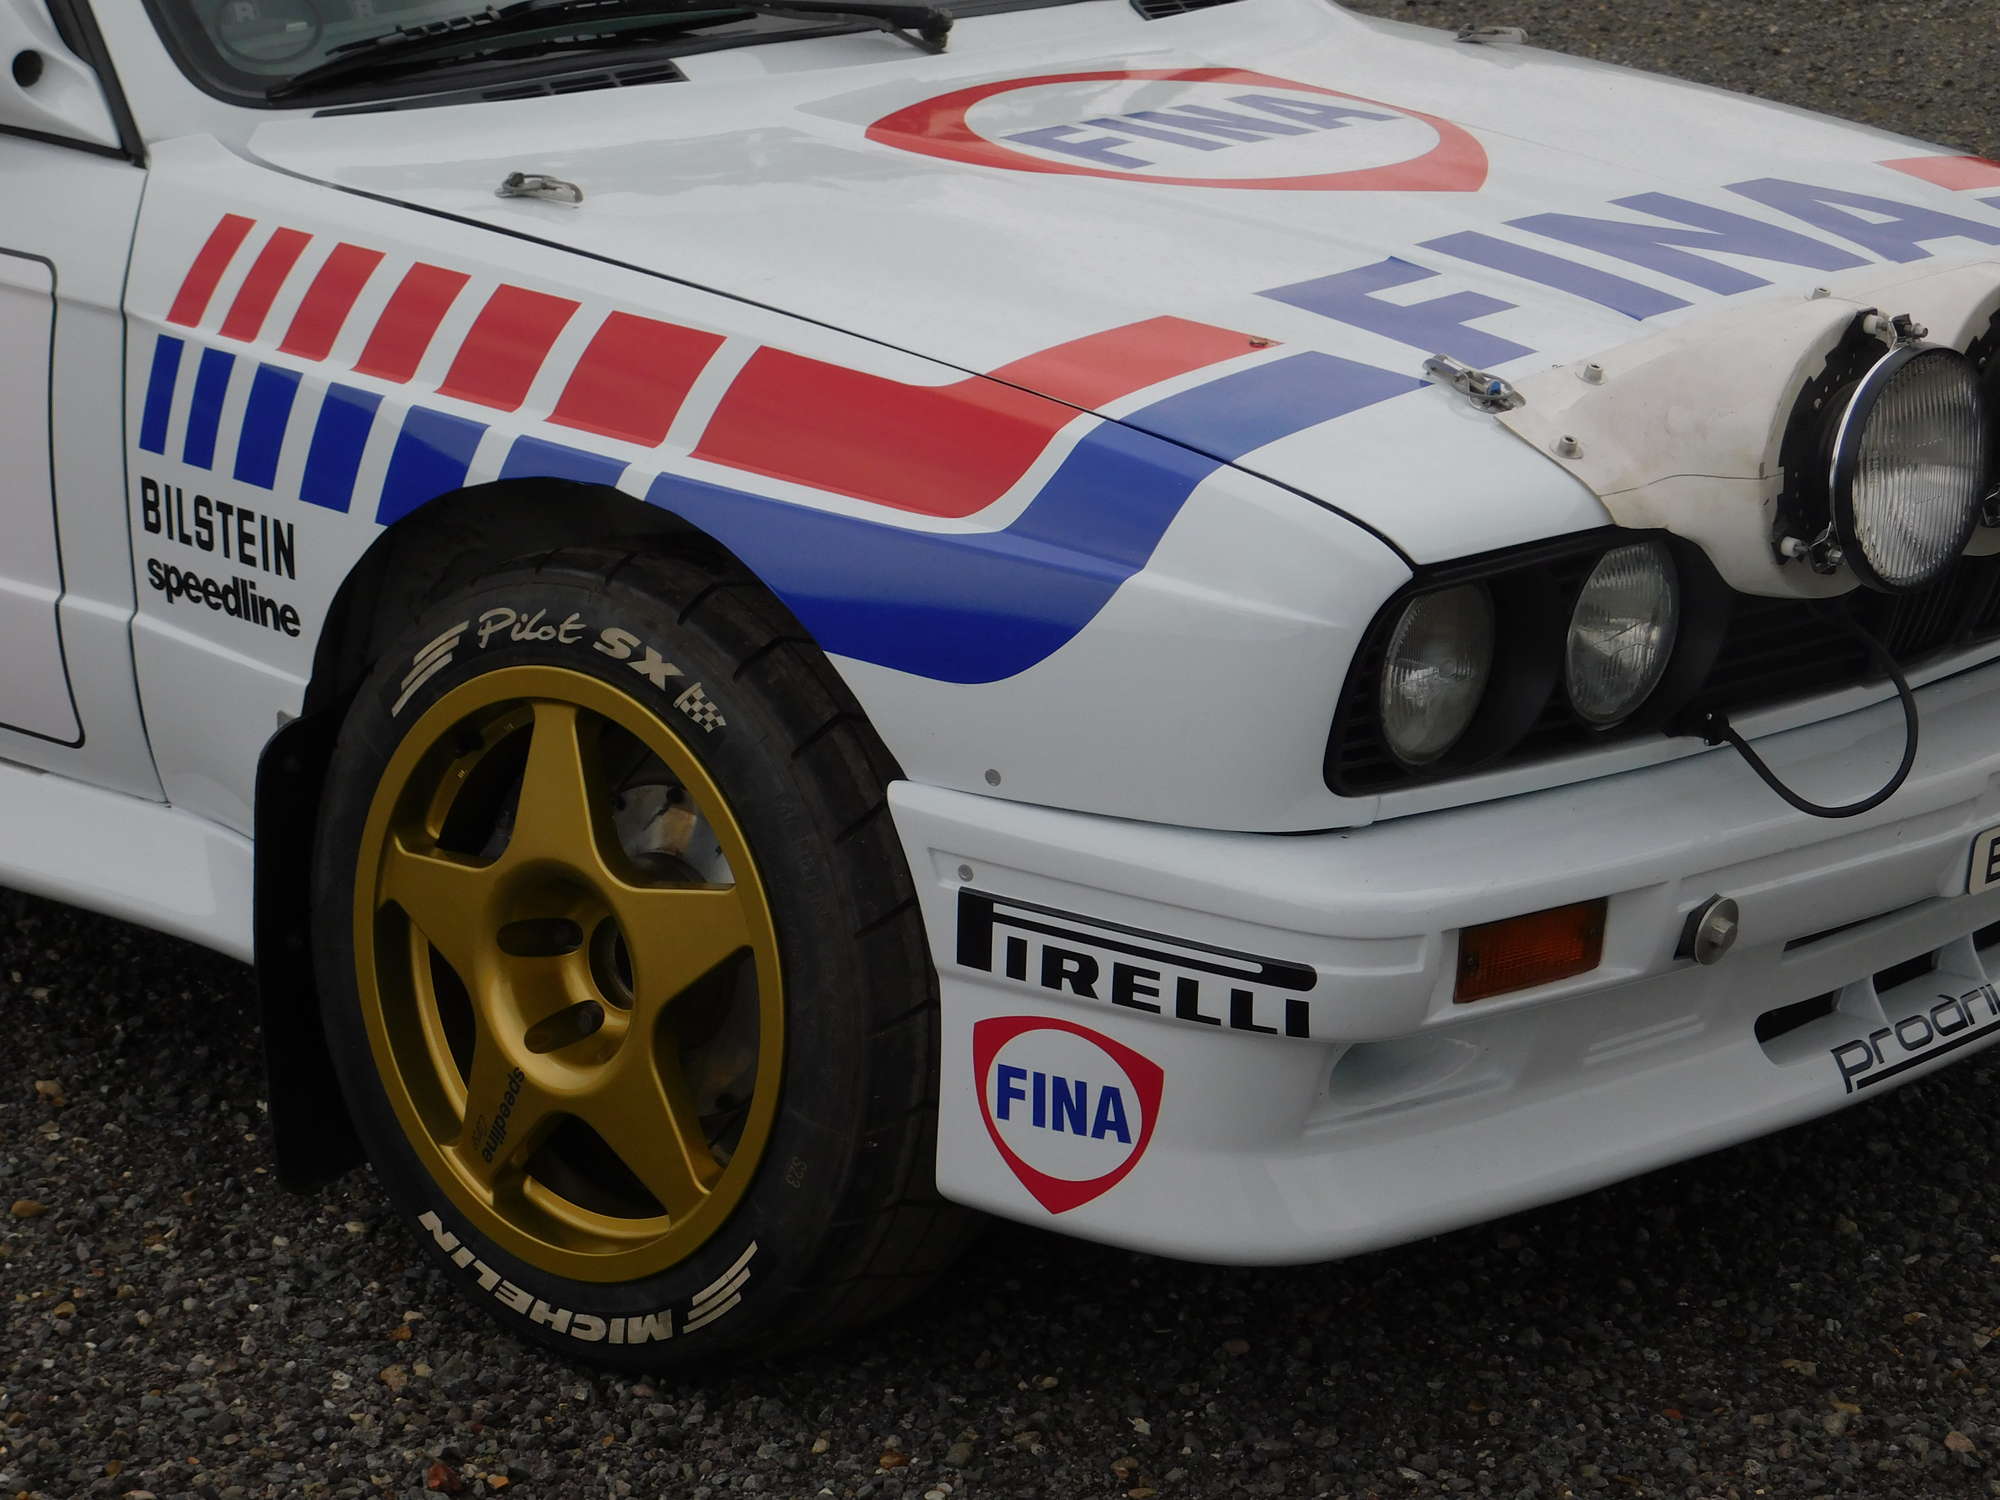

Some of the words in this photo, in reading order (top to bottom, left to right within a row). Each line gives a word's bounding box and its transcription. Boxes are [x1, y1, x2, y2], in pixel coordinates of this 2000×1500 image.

[999, 94, 1402, 169] FINA
[1251, 177, 2000, 369] FINA
[141, 476, 296, 580] BILSTEIN
[147, 558, 301, 637] speedline
[477, 607, 587, 648] Pilot
[593, 627, 685, 691] SX
[956, 886, 1318, 1038] PIRELLI
[482, 1067, 525, 1163] speedline
[997, 1063, 1132, 1144] FINA
[418, 1210, 673, 1344] MICHELIN
